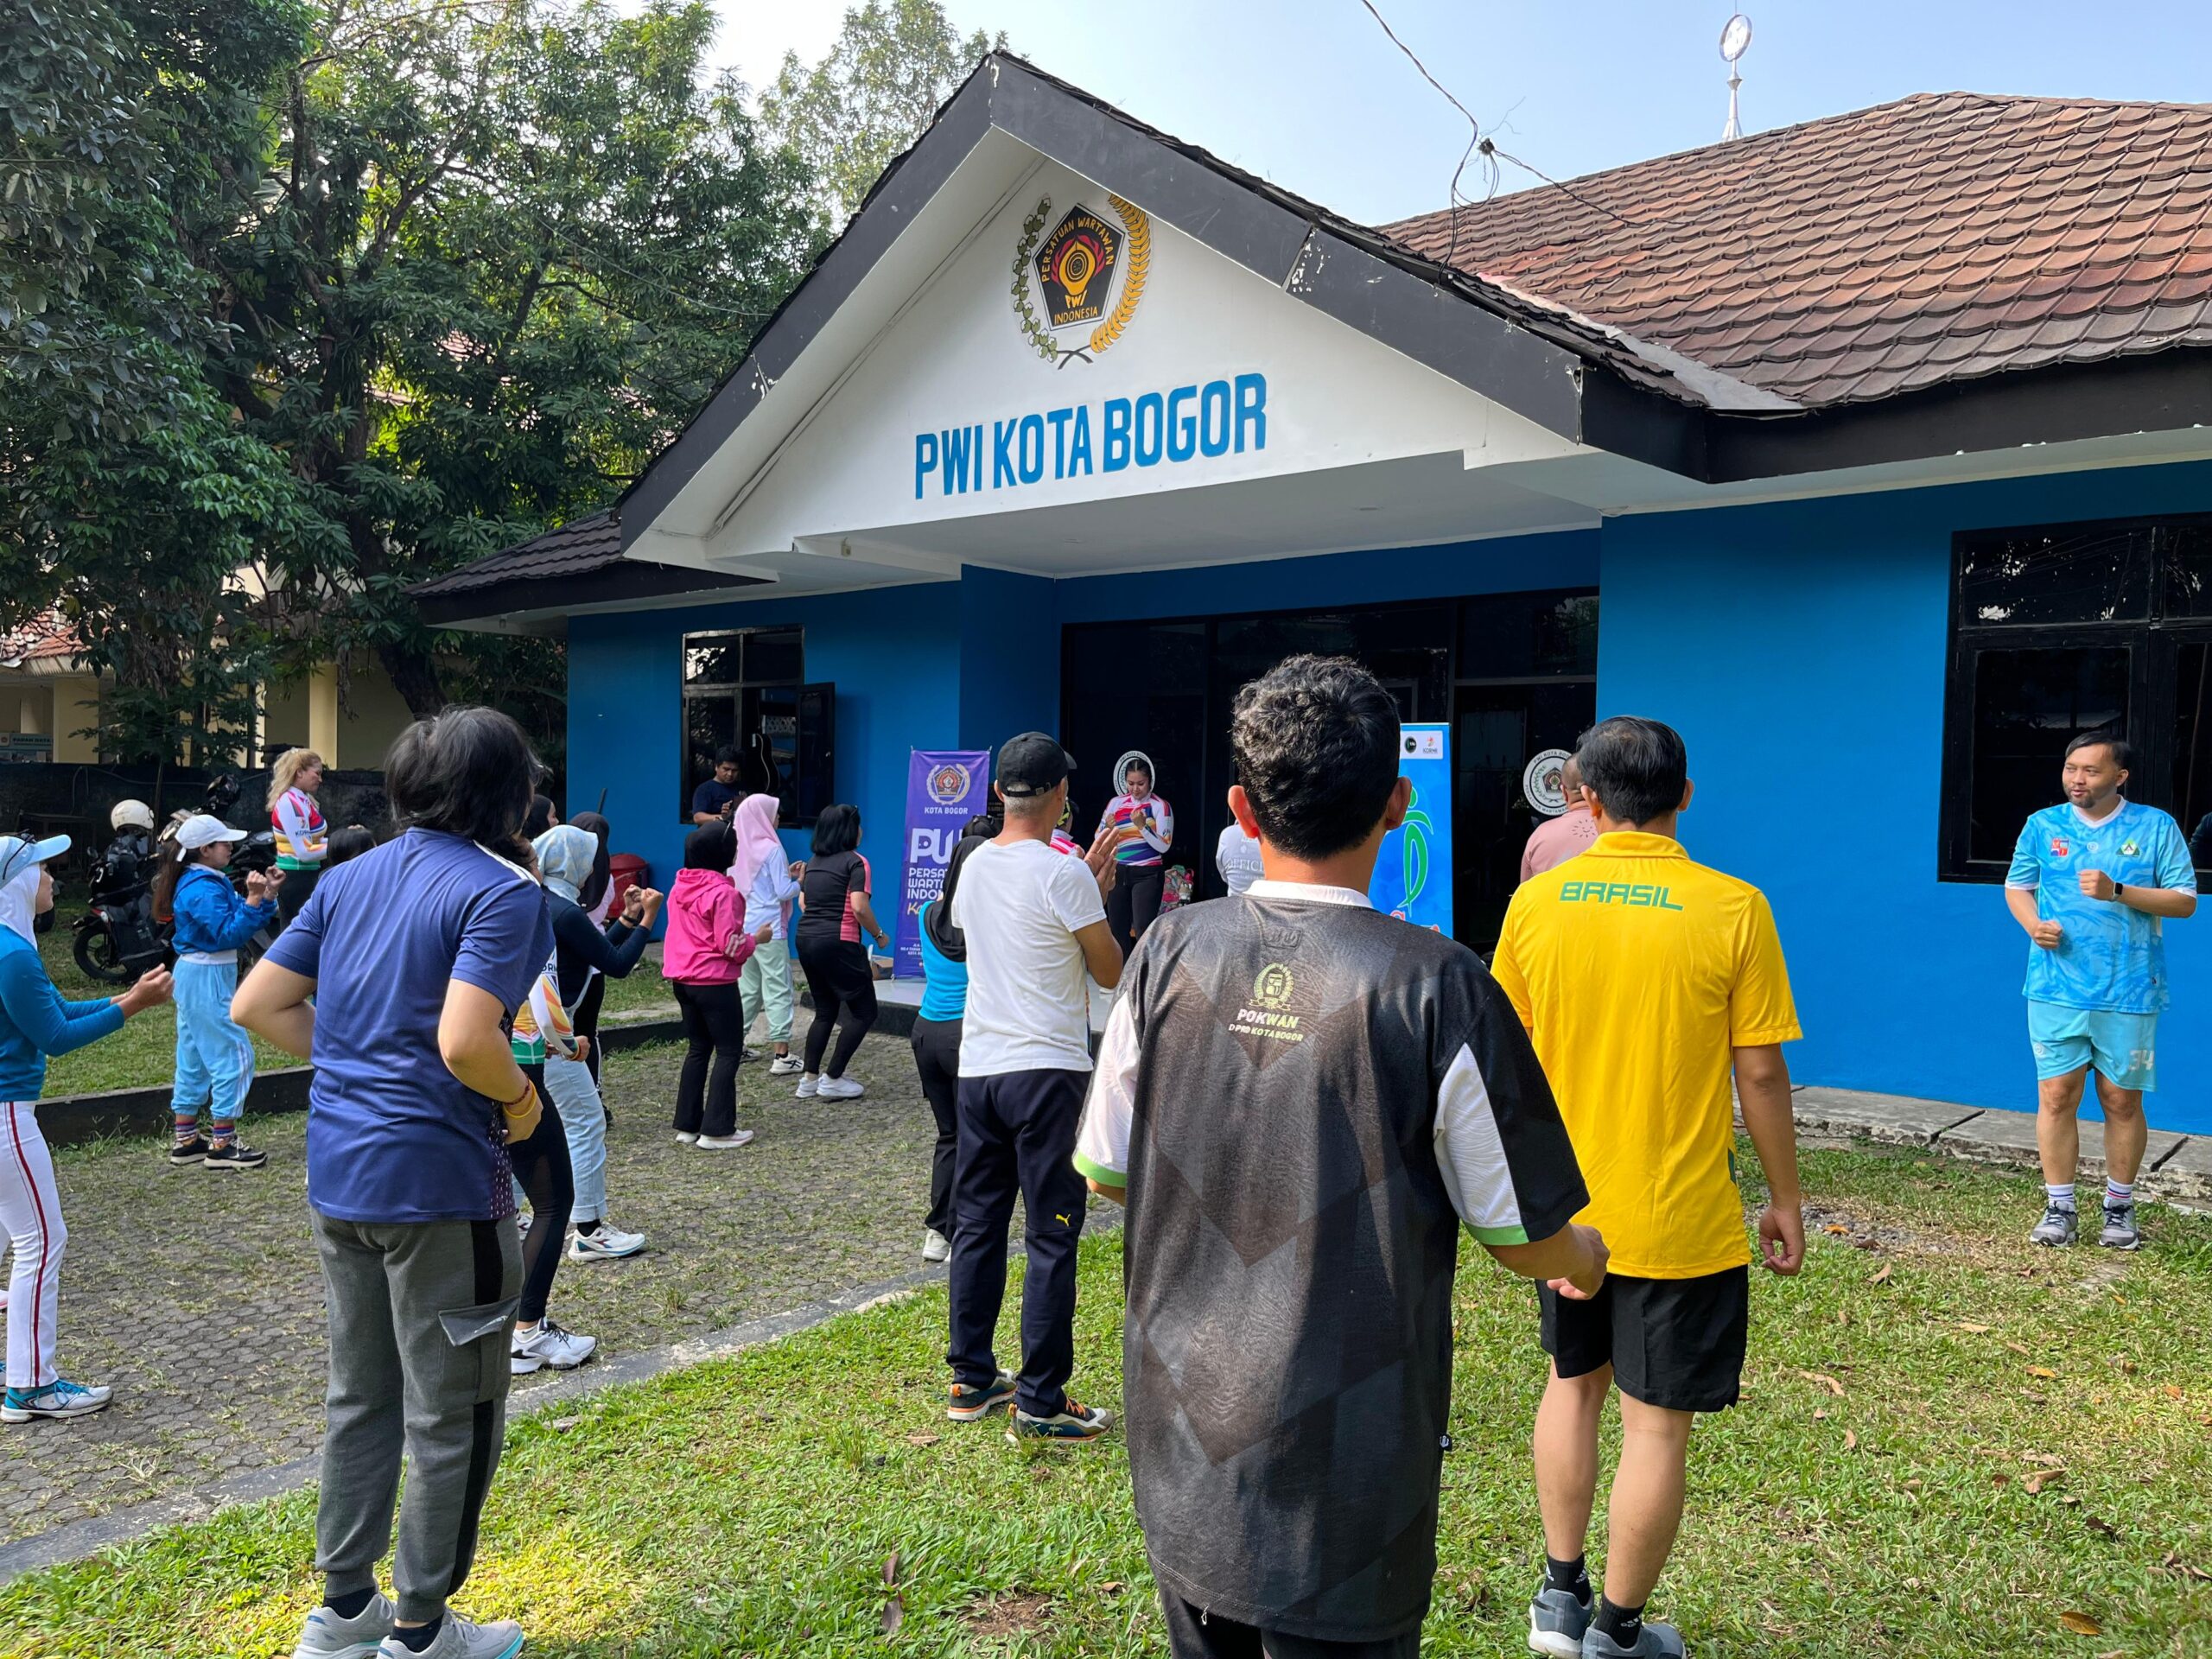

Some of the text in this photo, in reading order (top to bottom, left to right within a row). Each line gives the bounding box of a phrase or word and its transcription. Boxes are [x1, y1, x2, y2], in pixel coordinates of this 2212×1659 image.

[1042, 217, 1114, 283] PERSATUAN WARTAWAN
[1065, 289, 1087, 308] PWI
[1054, 306, 1098, 326] INDONESIA
[915, 372, 1268, 499] PWI KOTA BOGOR
[909, 868, 948, 878] PERSA
[1225, 857, 1263, 872] OFFICI
[908, 878, 944, 888] WART
[1559, 881, 1684, 911] BRASIL
[1236, 1008, 1300, 1028] POKWAN
[1251, 1027, 1274, 1038] KOTA
[1274, 1031, 1304, 1041] BOGOR
[2129, 1049, 2155, 1071] 34
